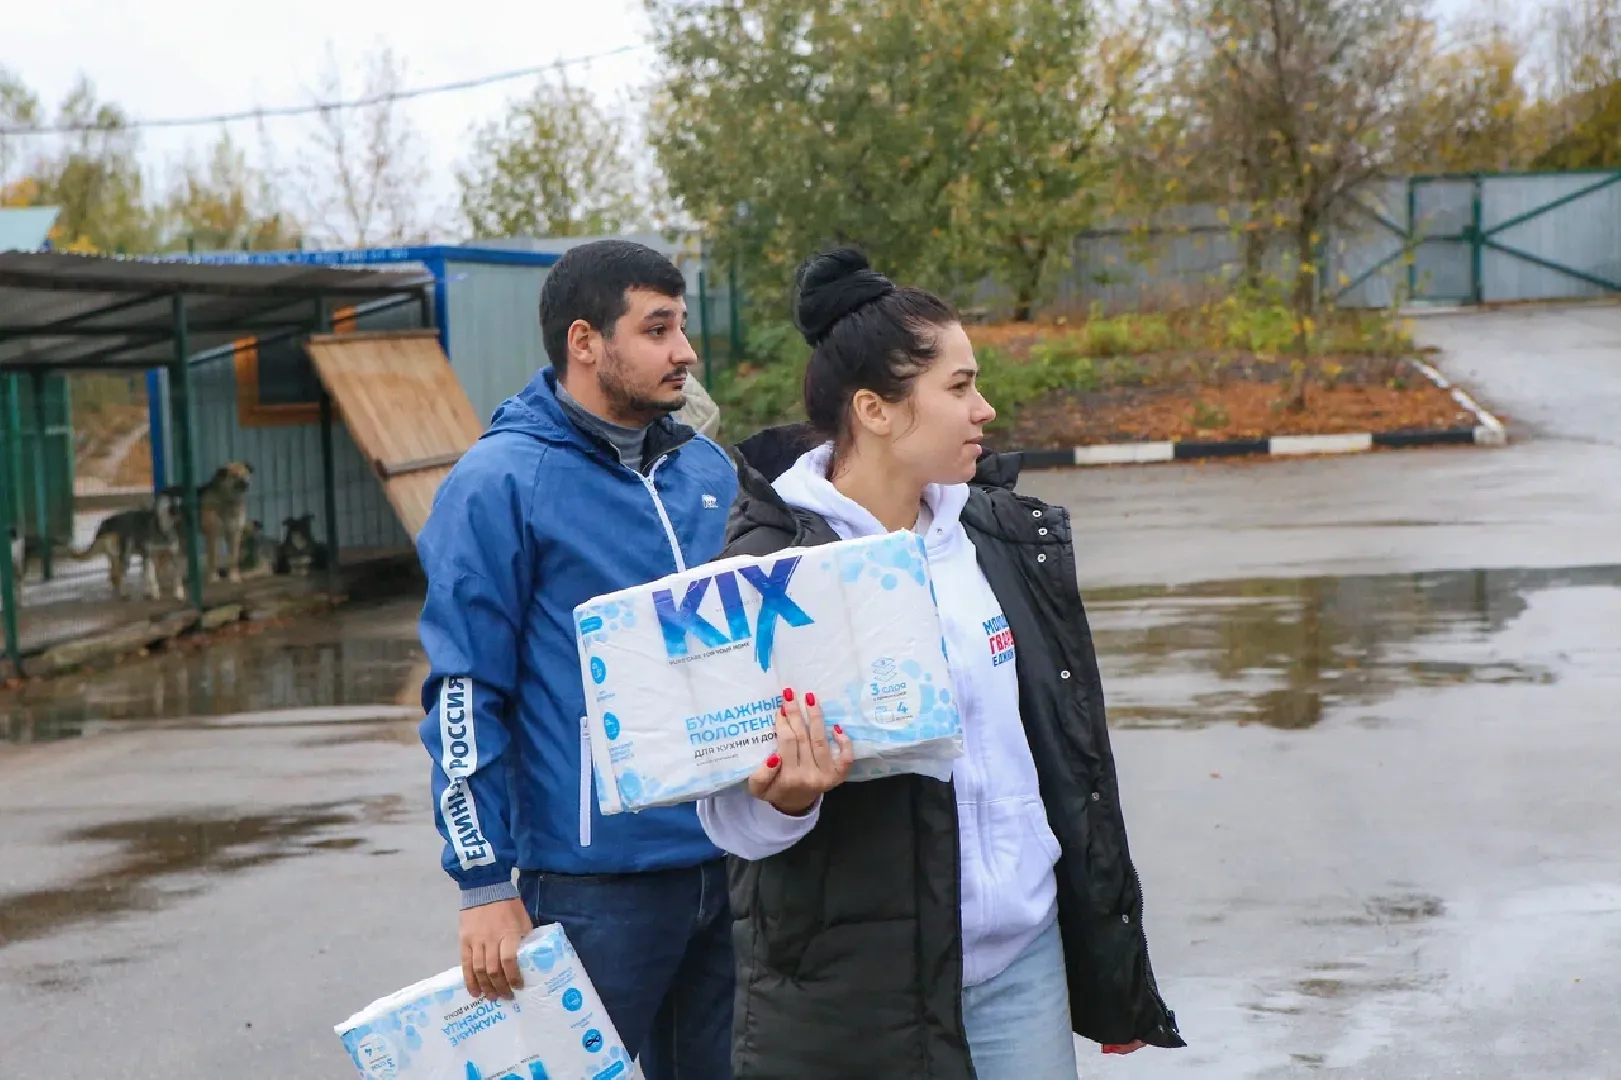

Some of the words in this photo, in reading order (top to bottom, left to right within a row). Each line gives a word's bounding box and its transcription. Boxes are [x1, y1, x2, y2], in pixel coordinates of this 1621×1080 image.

[652, 555, 815, 673] KIX
[446, 676, 469, 769] РОССИЯ
[685, 695, 783, 731] БУМАЖНЫЕ
[694, 747, 715, 759] ДЛЯ
[716, 738, 750, 752] КУХНИ
[752, 735, 759, 744] И
